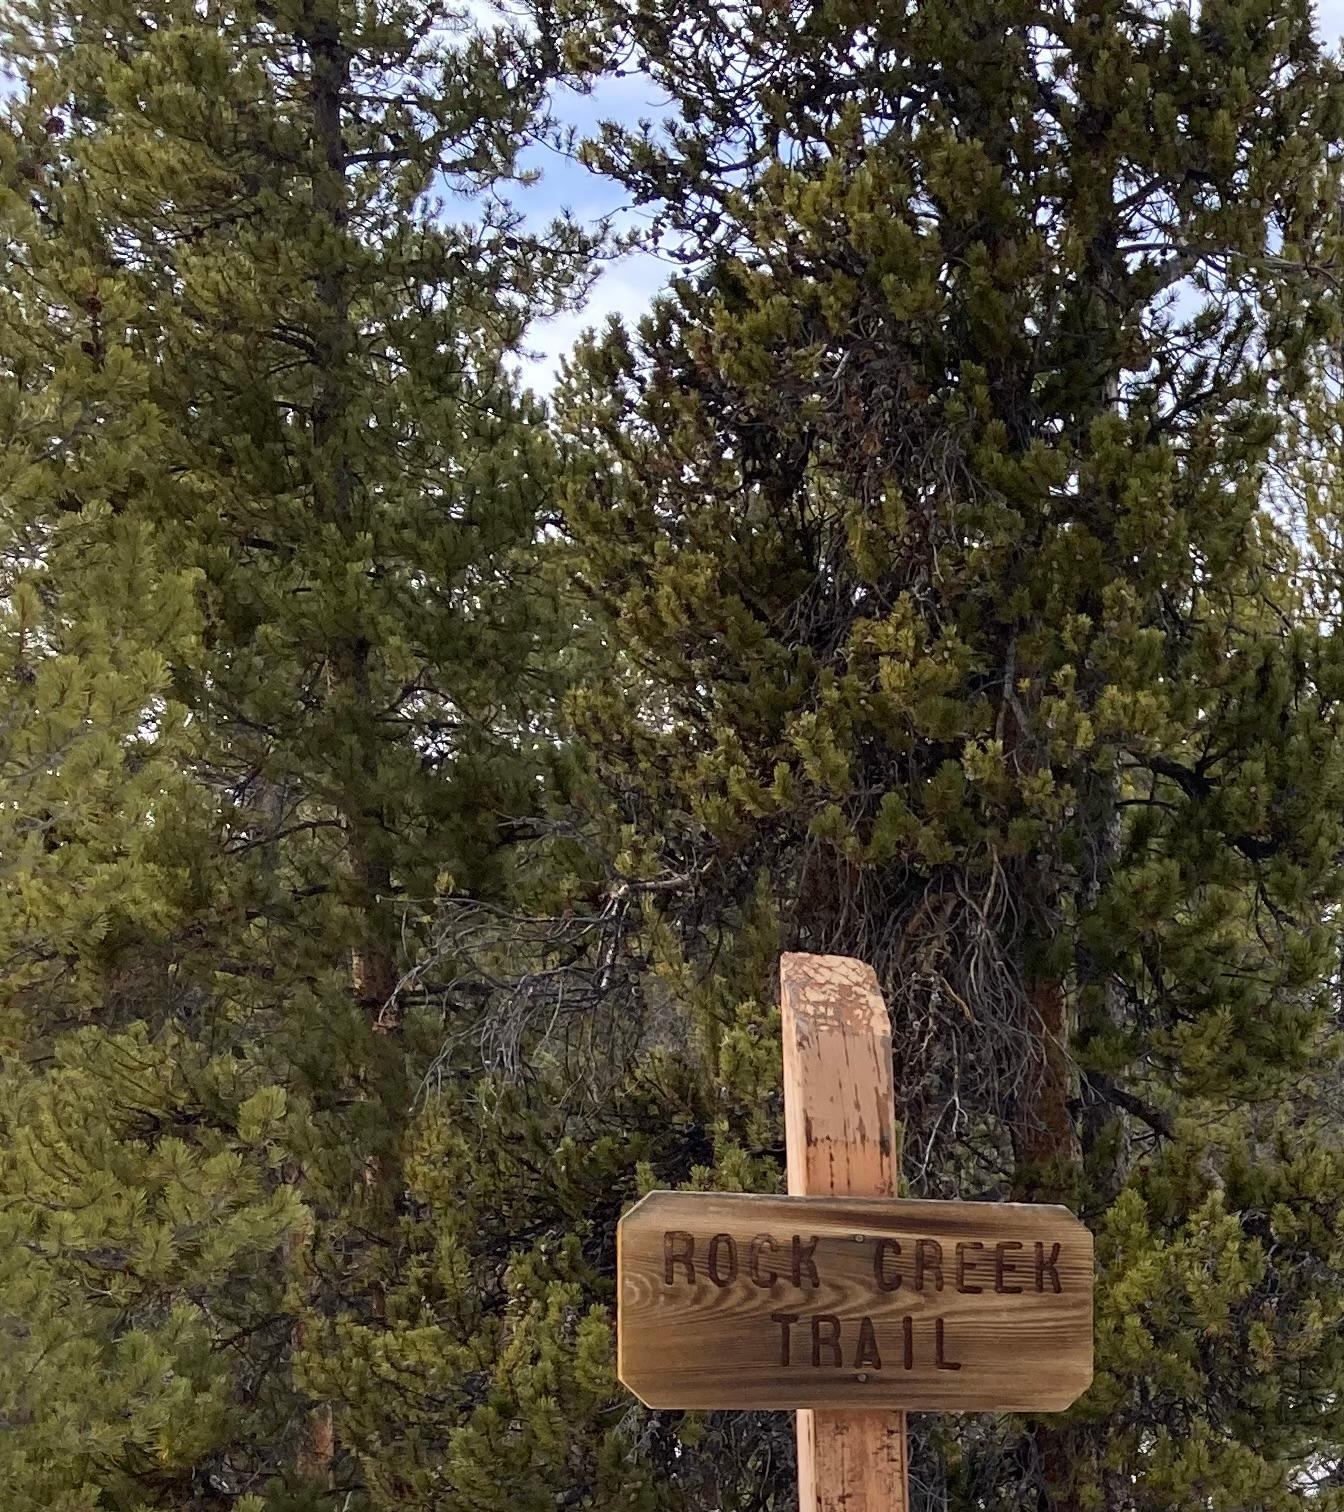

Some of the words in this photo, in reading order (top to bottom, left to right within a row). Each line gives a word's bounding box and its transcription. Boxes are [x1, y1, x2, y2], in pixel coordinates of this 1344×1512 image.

[663, 1230, 820, 1289] ROCK
[873, 1237, 1062, 1294] CREEK
[771, 1312, 962, 1371] TRAIL
